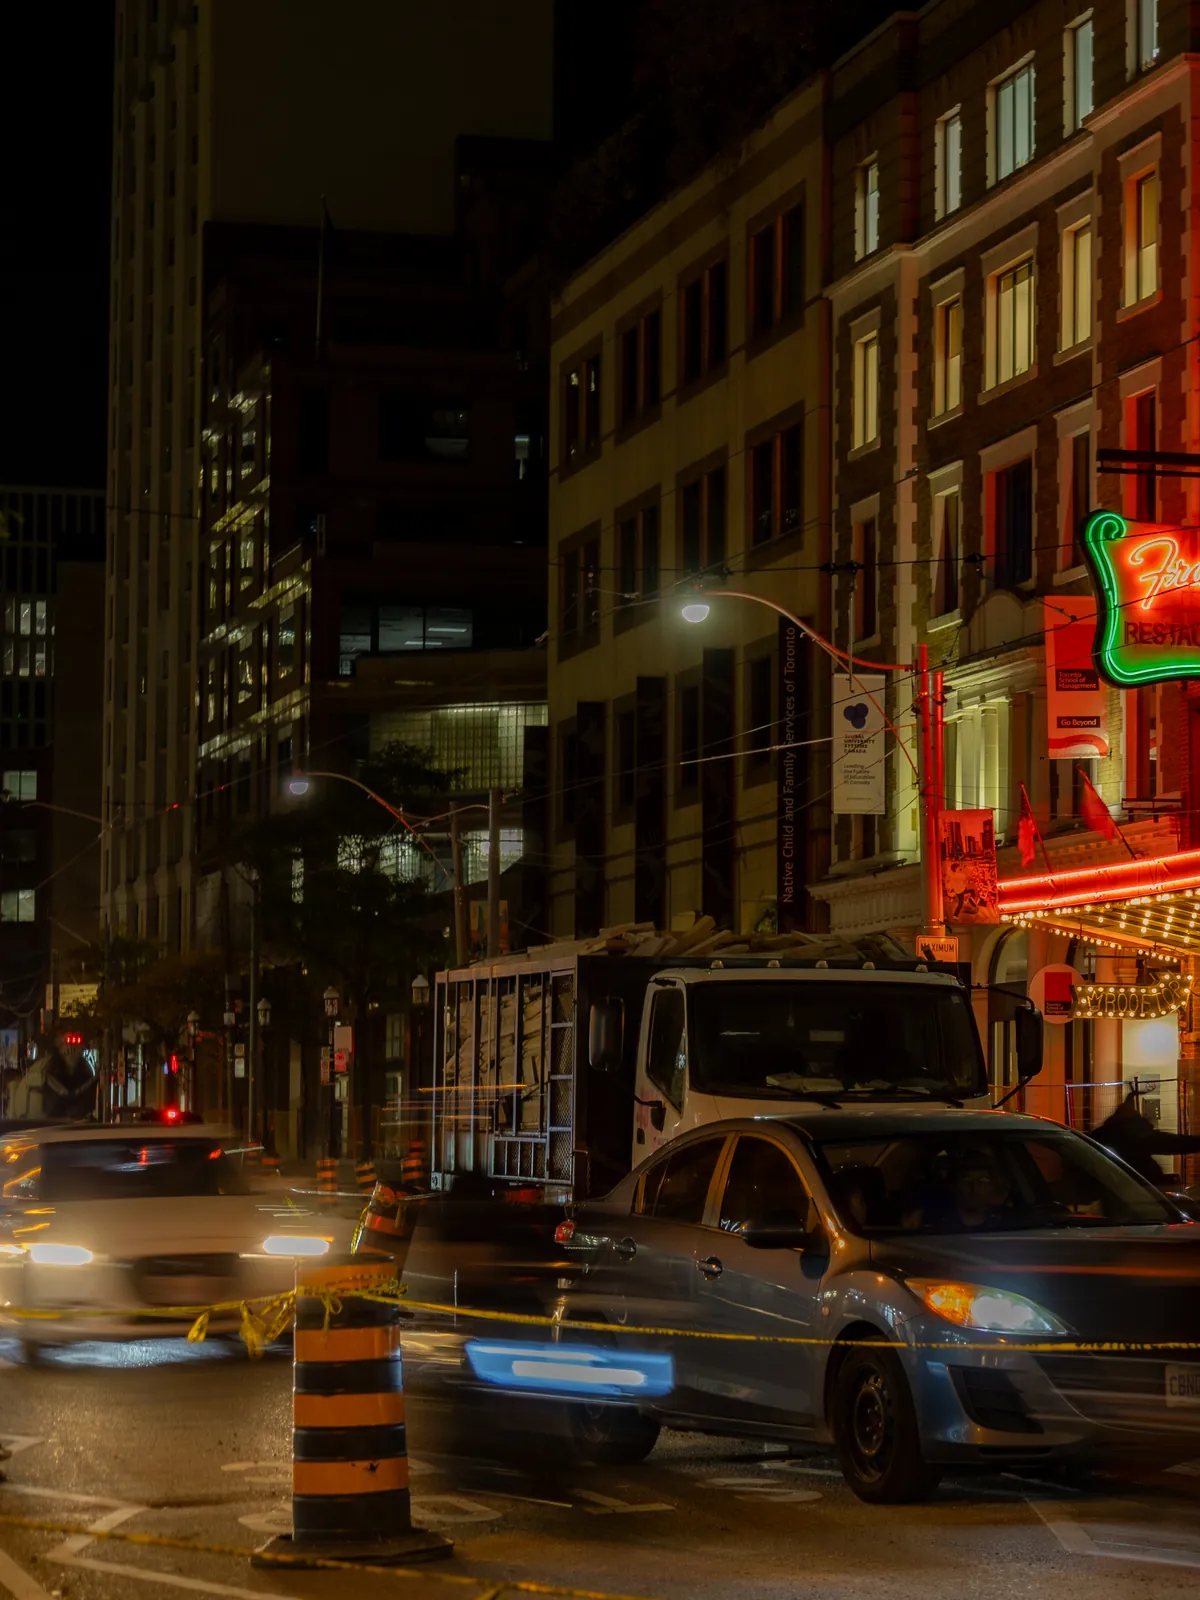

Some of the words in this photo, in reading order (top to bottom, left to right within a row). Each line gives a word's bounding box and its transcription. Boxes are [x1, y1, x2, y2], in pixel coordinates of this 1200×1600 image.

[784, 627, 796, 675] Toronto
[783, 679, 795, 692] of
[783, 696, 795, 748] Services
[1072, 719, 1097, 727] Beyond
[783, 751, 797, 794] Family
[782, 798, 794, 821] and
[782, 825, 794, 858] Child
[782, 861, 793, 903] Native
[1103, 980, 1181, 1013] ROOFTOP
